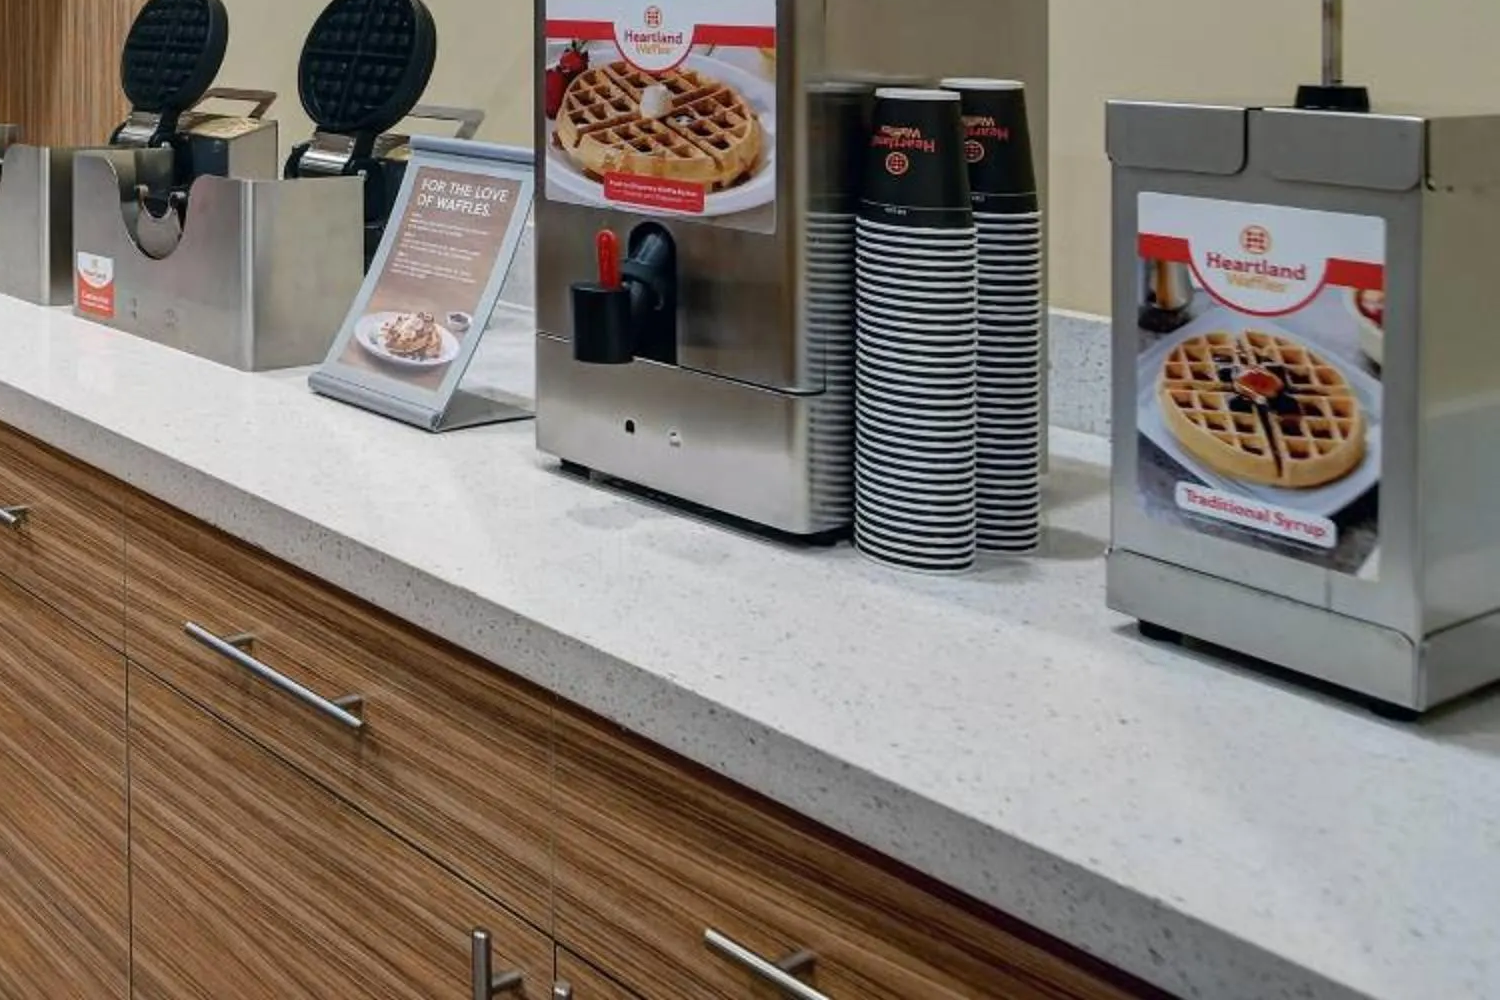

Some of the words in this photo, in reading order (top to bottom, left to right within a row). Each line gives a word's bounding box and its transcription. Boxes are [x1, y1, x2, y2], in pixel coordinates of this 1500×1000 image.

[624, 29, 683, 45] Heartland
[417, 193, 435, 207] OF
[421, 178, 447, 193] FOR
[449, 182, 474, 197] THE
[474, 186, 510, 203] LOVE
[1205, 251, 1307, 281] Heartland
[1186, 487, 1271, 523] Traditional
[1272, 511, 1327, 539] Syrup
